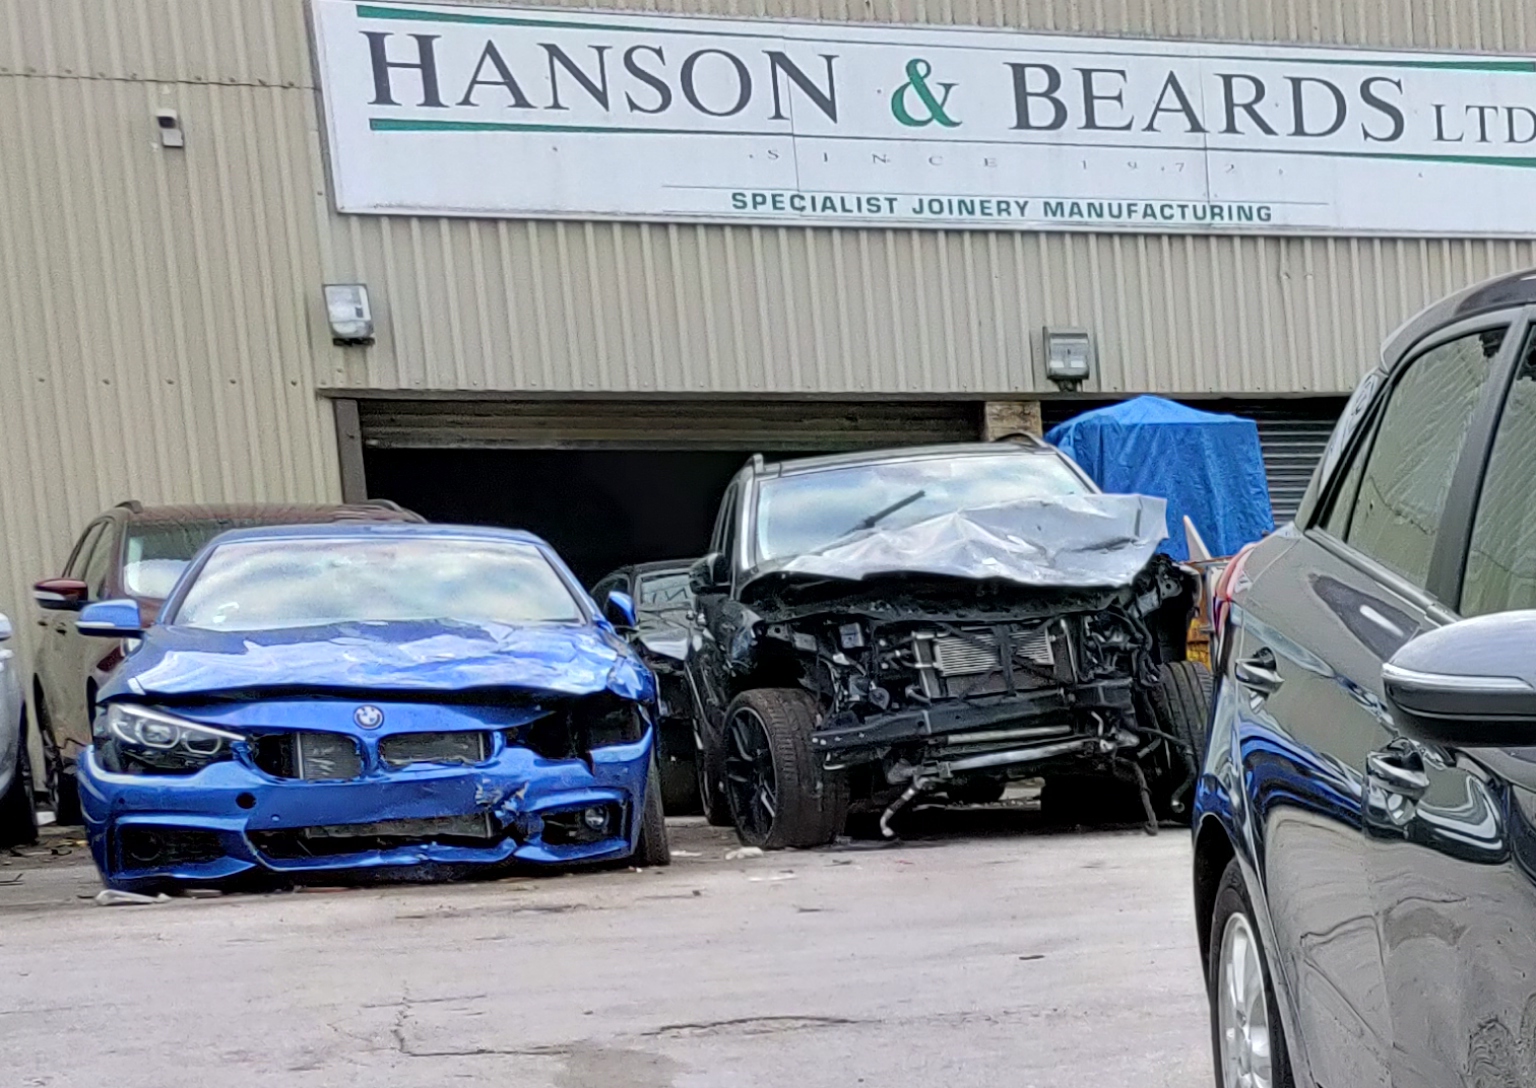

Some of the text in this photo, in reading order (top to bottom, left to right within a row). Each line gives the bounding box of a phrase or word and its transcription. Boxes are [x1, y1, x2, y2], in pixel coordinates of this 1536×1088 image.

[359, 31, 840, 125] HANSON
[891, 58, 963, 128] &
[1003, 61, 1406, 143] BEARDS
[731, 191, 1272, 223] SPECIALIST JOINERY MANUFACTURING
